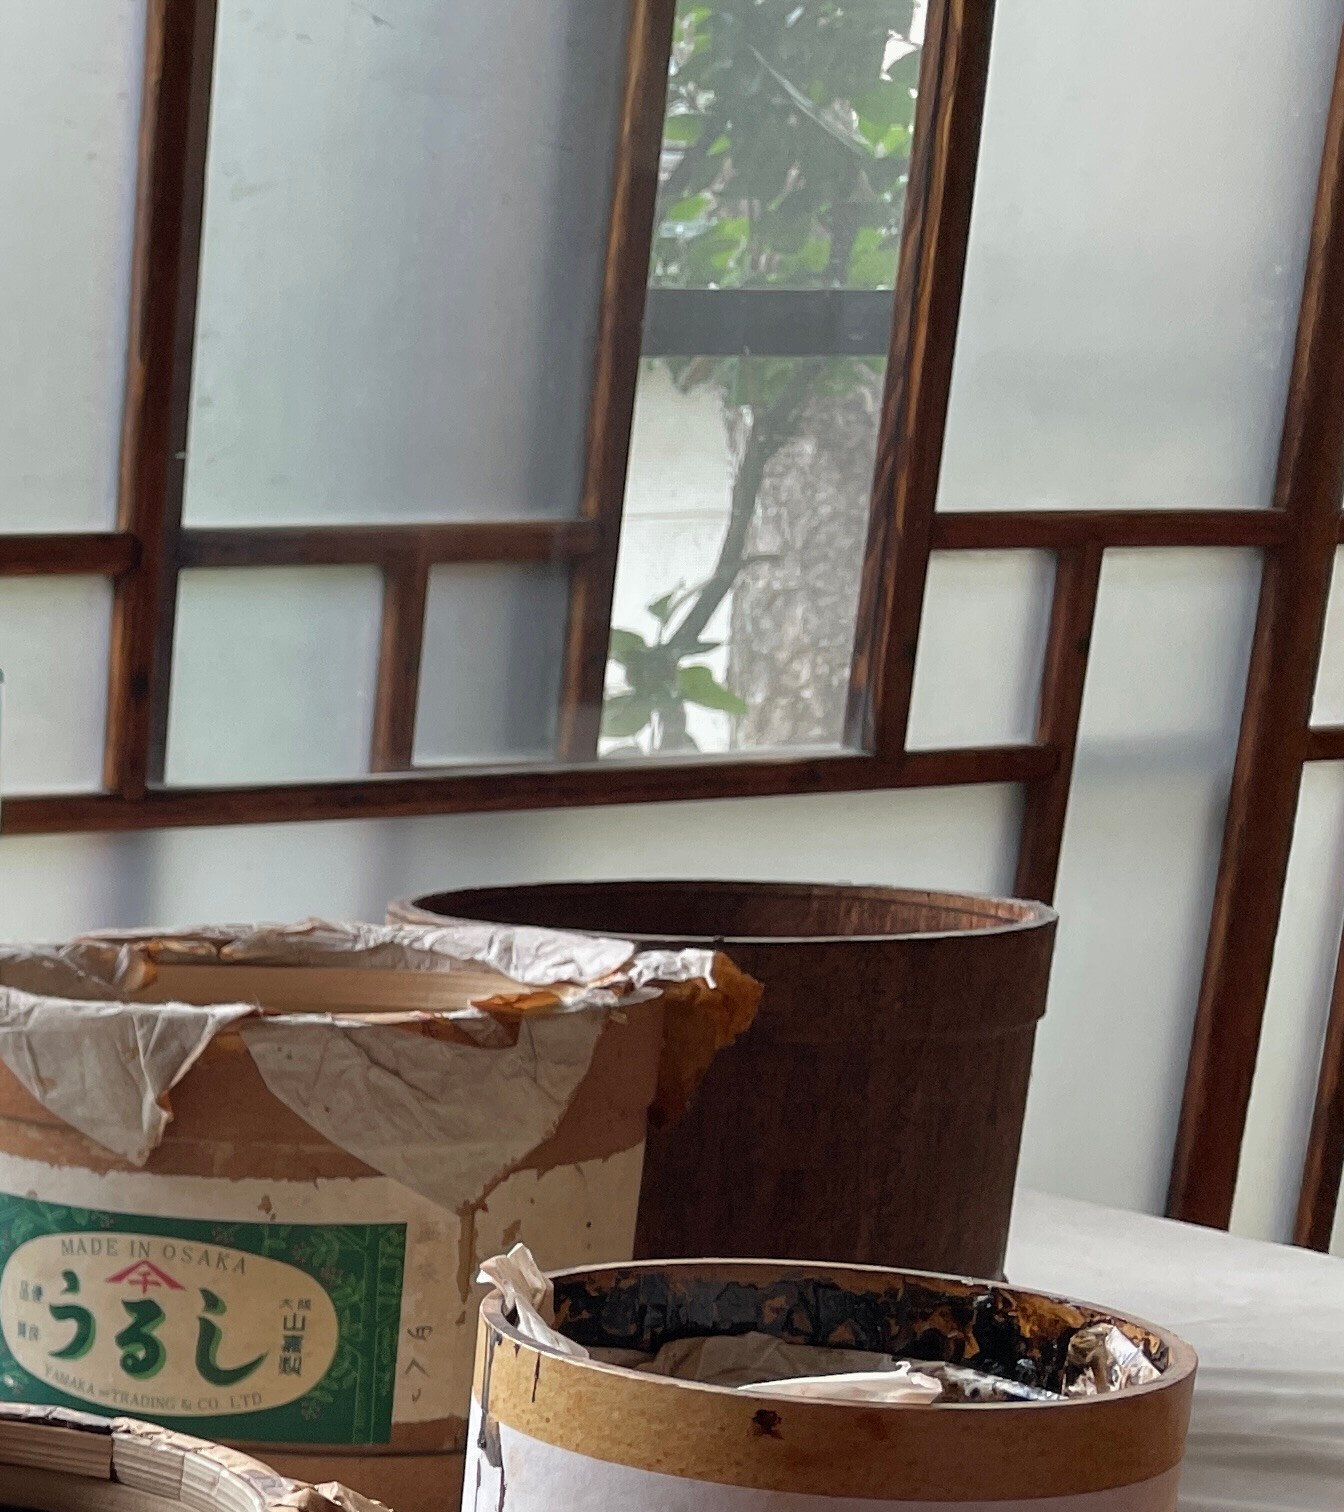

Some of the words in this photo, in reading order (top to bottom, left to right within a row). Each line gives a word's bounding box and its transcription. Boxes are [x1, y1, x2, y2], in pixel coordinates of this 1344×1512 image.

[61, 1237, 119, 1258] MADE
[129, 1239, 151, 1259] IN
[161, 1243, 248, 1276] OSAKA
[47, 1269, 269, 1387] うるし
